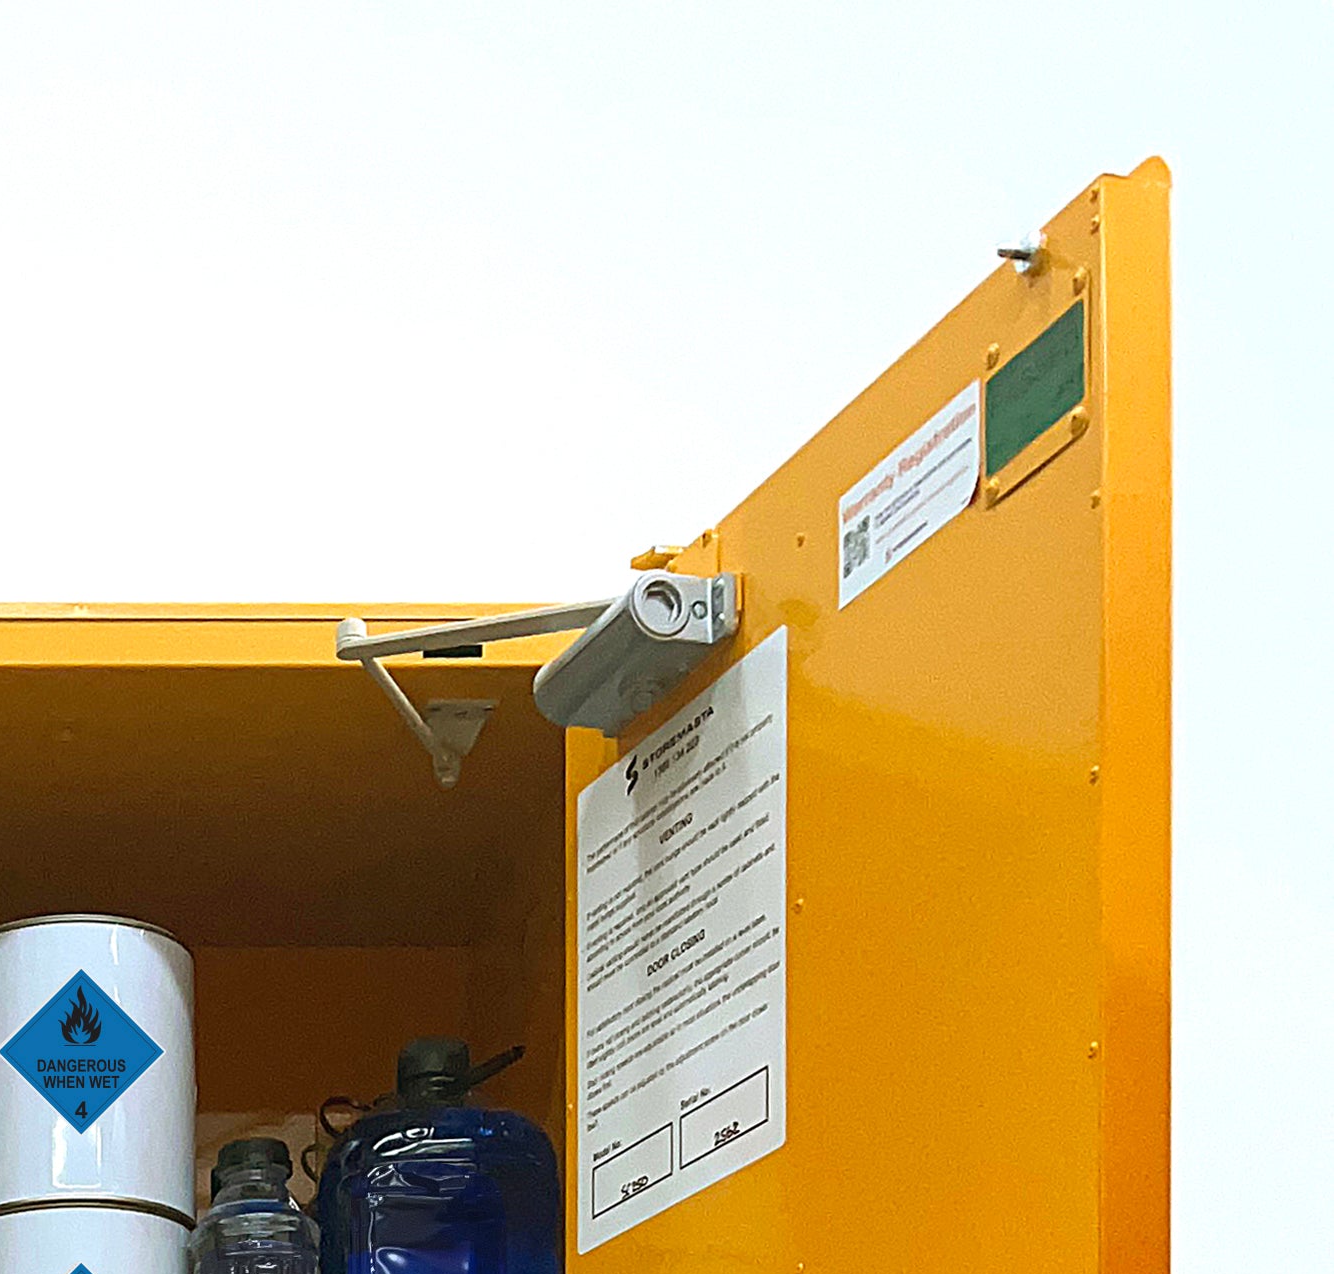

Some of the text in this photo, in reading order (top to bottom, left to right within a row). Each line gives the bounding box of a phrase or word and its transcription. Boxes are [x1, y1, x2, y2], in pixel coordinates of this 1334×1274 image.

[647, 928, 705, 977] DOOR CLOSING
[36, 1058, 127, 1073] DANGEROUS
[43, 1075, 120, 1089] WHEN WET
[74, 1100, 89, 1119] 4
